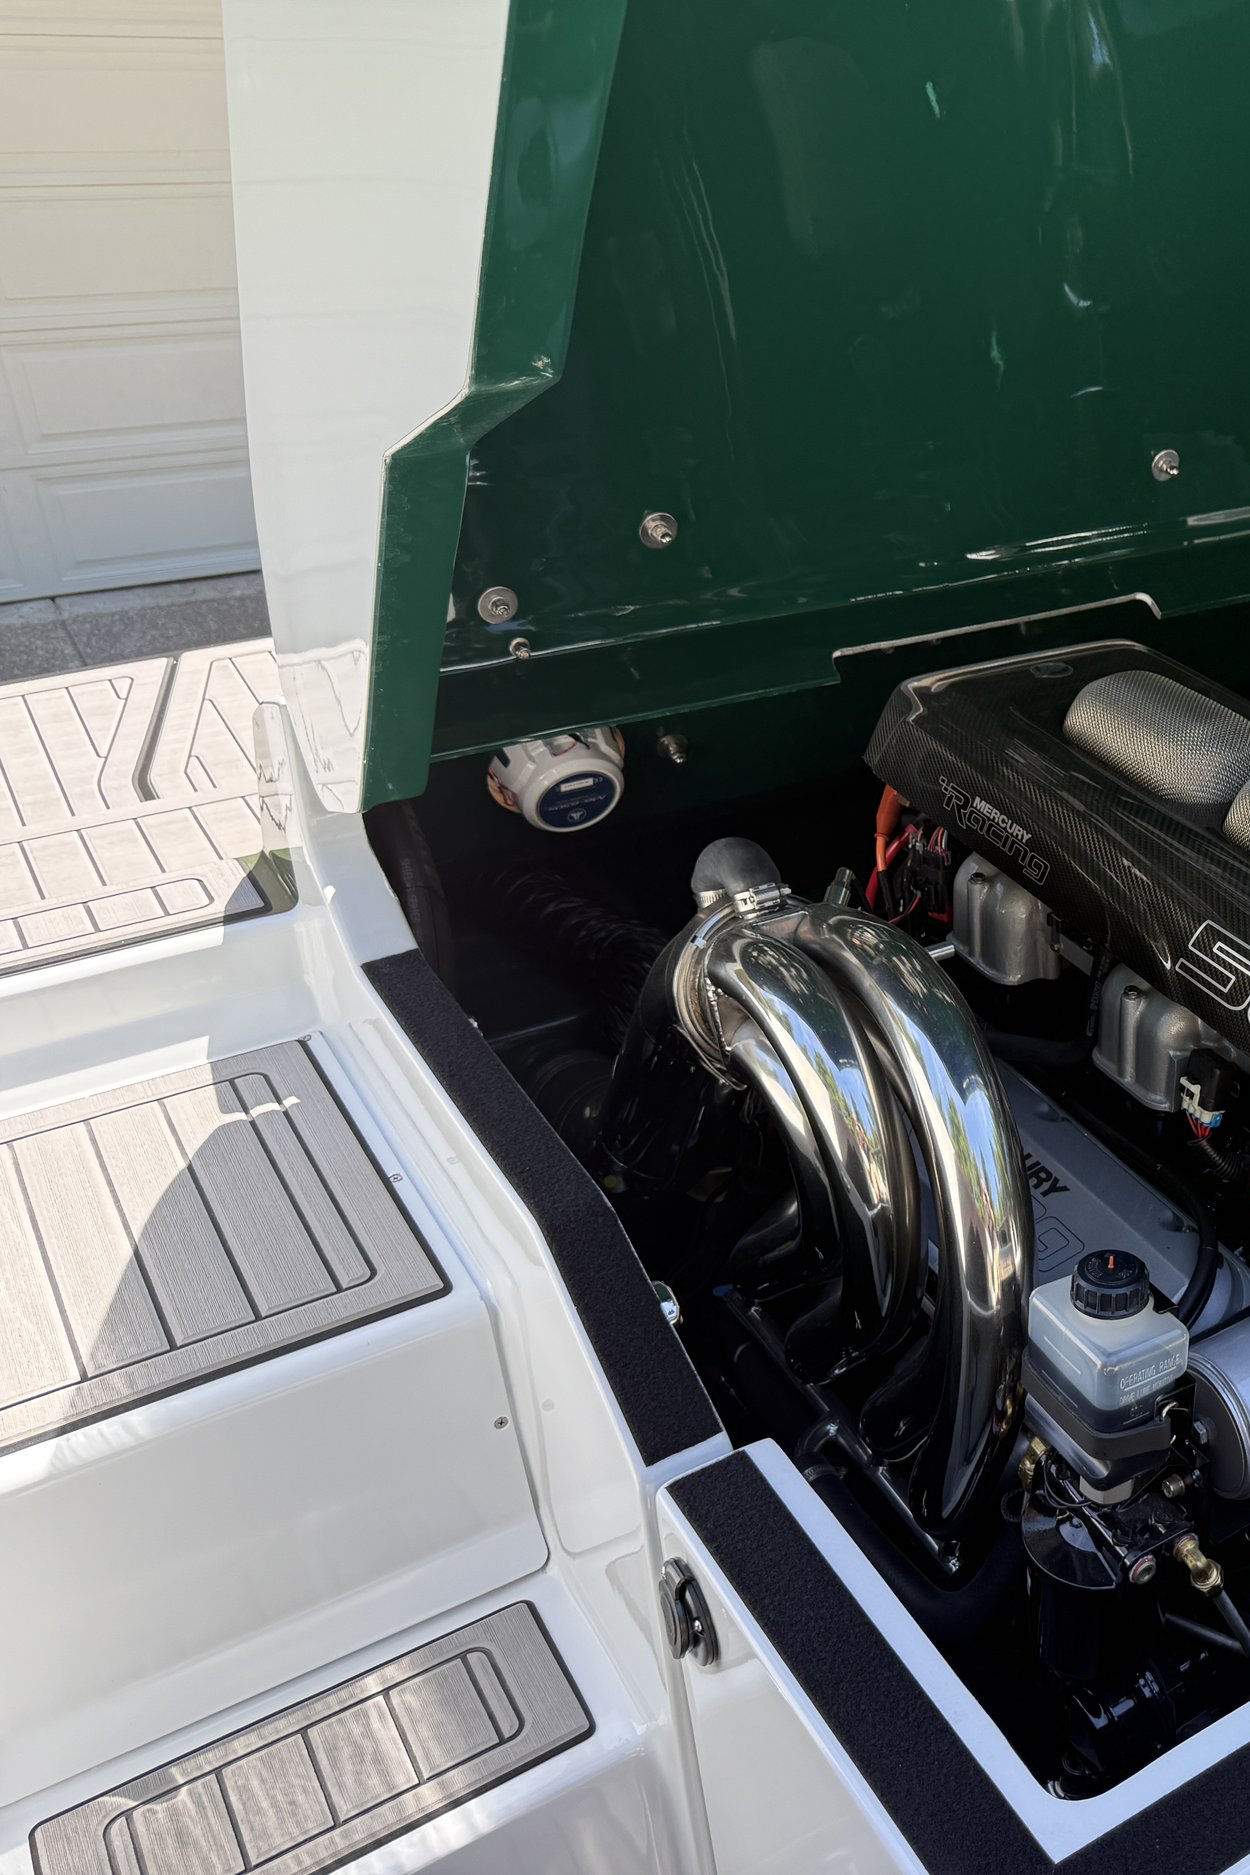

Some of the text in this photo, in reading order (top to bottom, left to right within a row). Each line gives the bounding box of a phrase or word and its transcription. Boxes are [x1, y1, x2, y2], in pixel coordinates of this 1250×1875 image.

[939, 776, 1051, 886] Racing
[973, 796, 1033, 844] MERCURY
[1120, 1353, 1181, 1390] OPERATING RANGE
